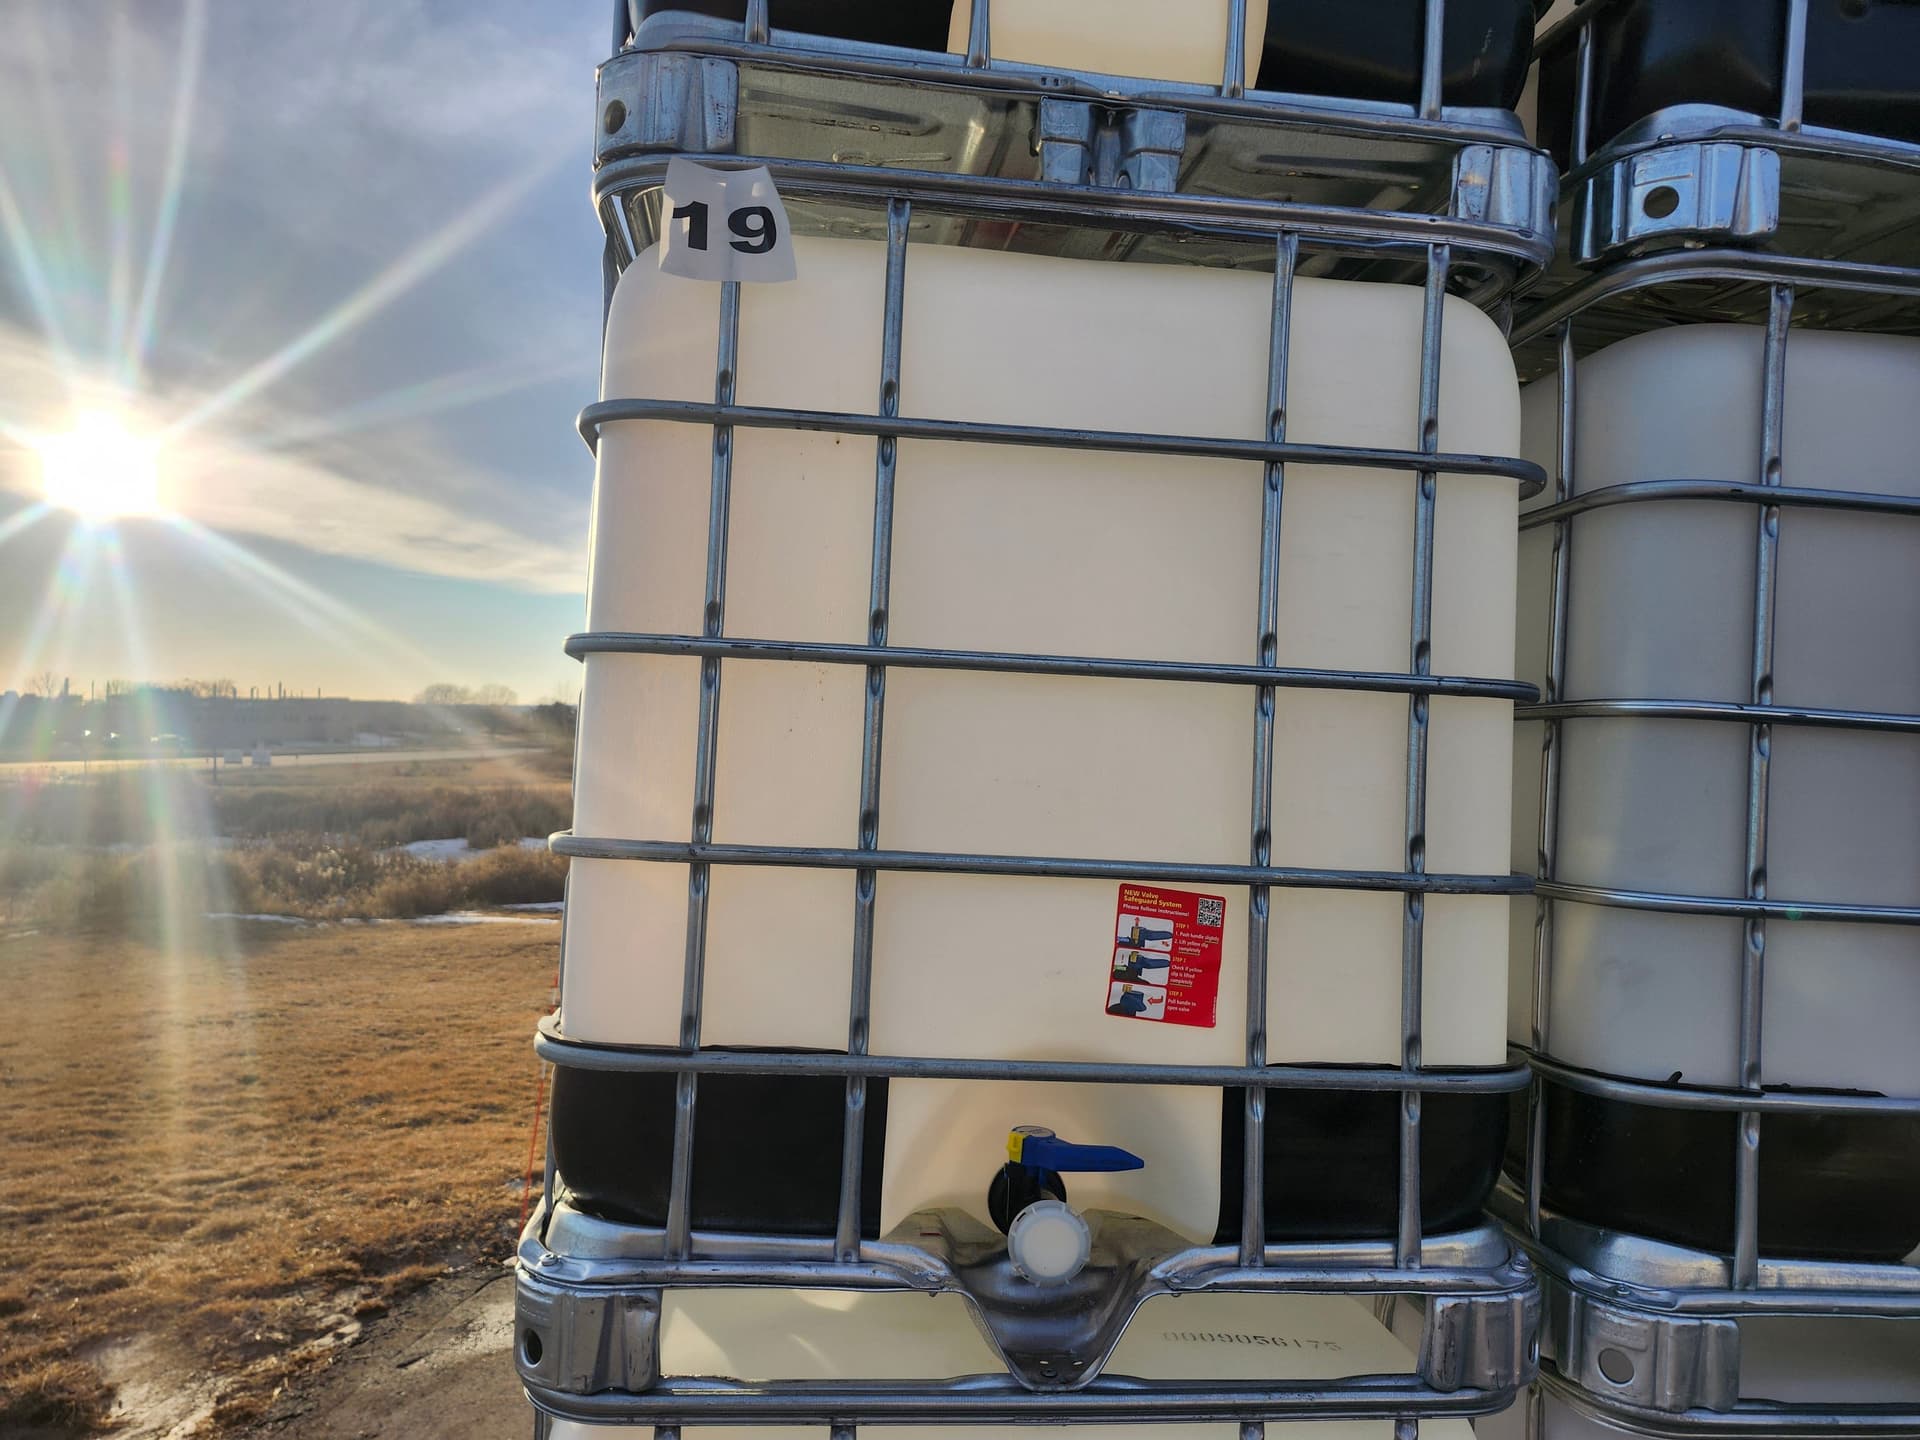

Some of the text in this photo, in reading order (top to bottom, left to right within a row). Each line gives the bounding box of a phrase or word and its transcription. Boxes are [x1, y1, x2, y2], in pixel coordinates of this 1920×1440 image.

[673, 201, 777, 254] 19
[1124, 889, 1140, 897] NEW
[1124, 895, 1182, 909] Safeguard System
